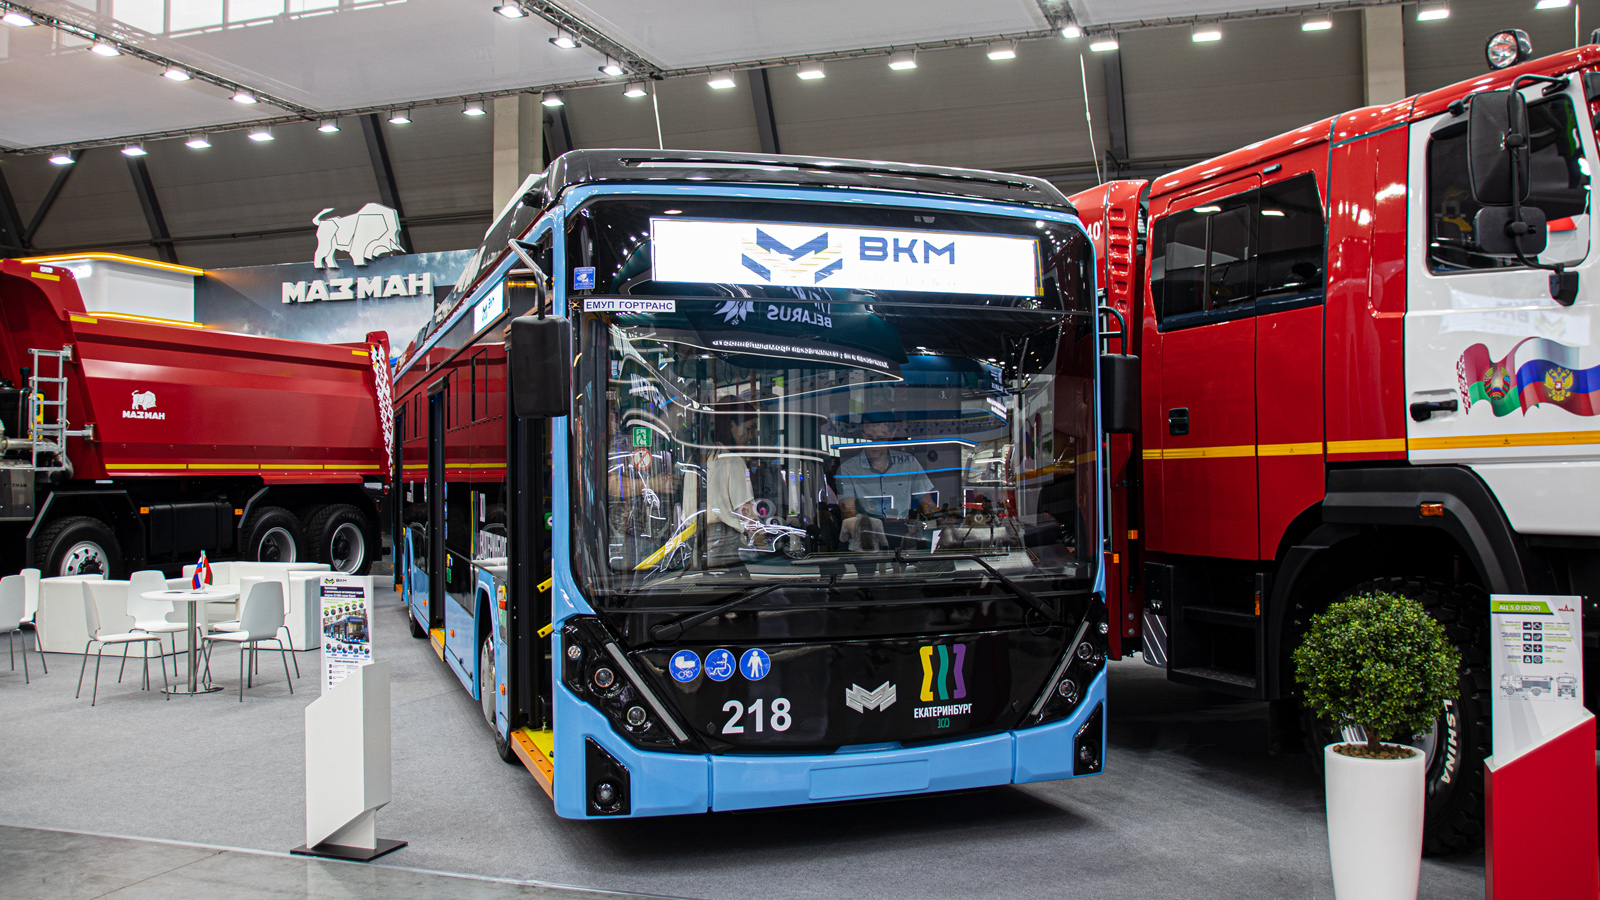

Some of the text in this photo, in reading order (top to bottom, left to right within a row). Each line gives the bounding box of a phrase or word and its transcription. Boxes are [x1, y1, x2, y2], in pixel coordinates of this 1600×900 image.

[859, 236, 955, 265] BKM
[282, 272, 433, 304] МАЗМАН
[586, 301, 673, 310] ЕМУП ГОРТРАНС
[122, 410, 166, 420] МАЗМАН
[1498, 604, 1541, 612] АЦ 5,0 (5309)
[721, 697, 792, 734] 218
[913, 703, 973, 718] ЕКАТЕРИНБУРГ
